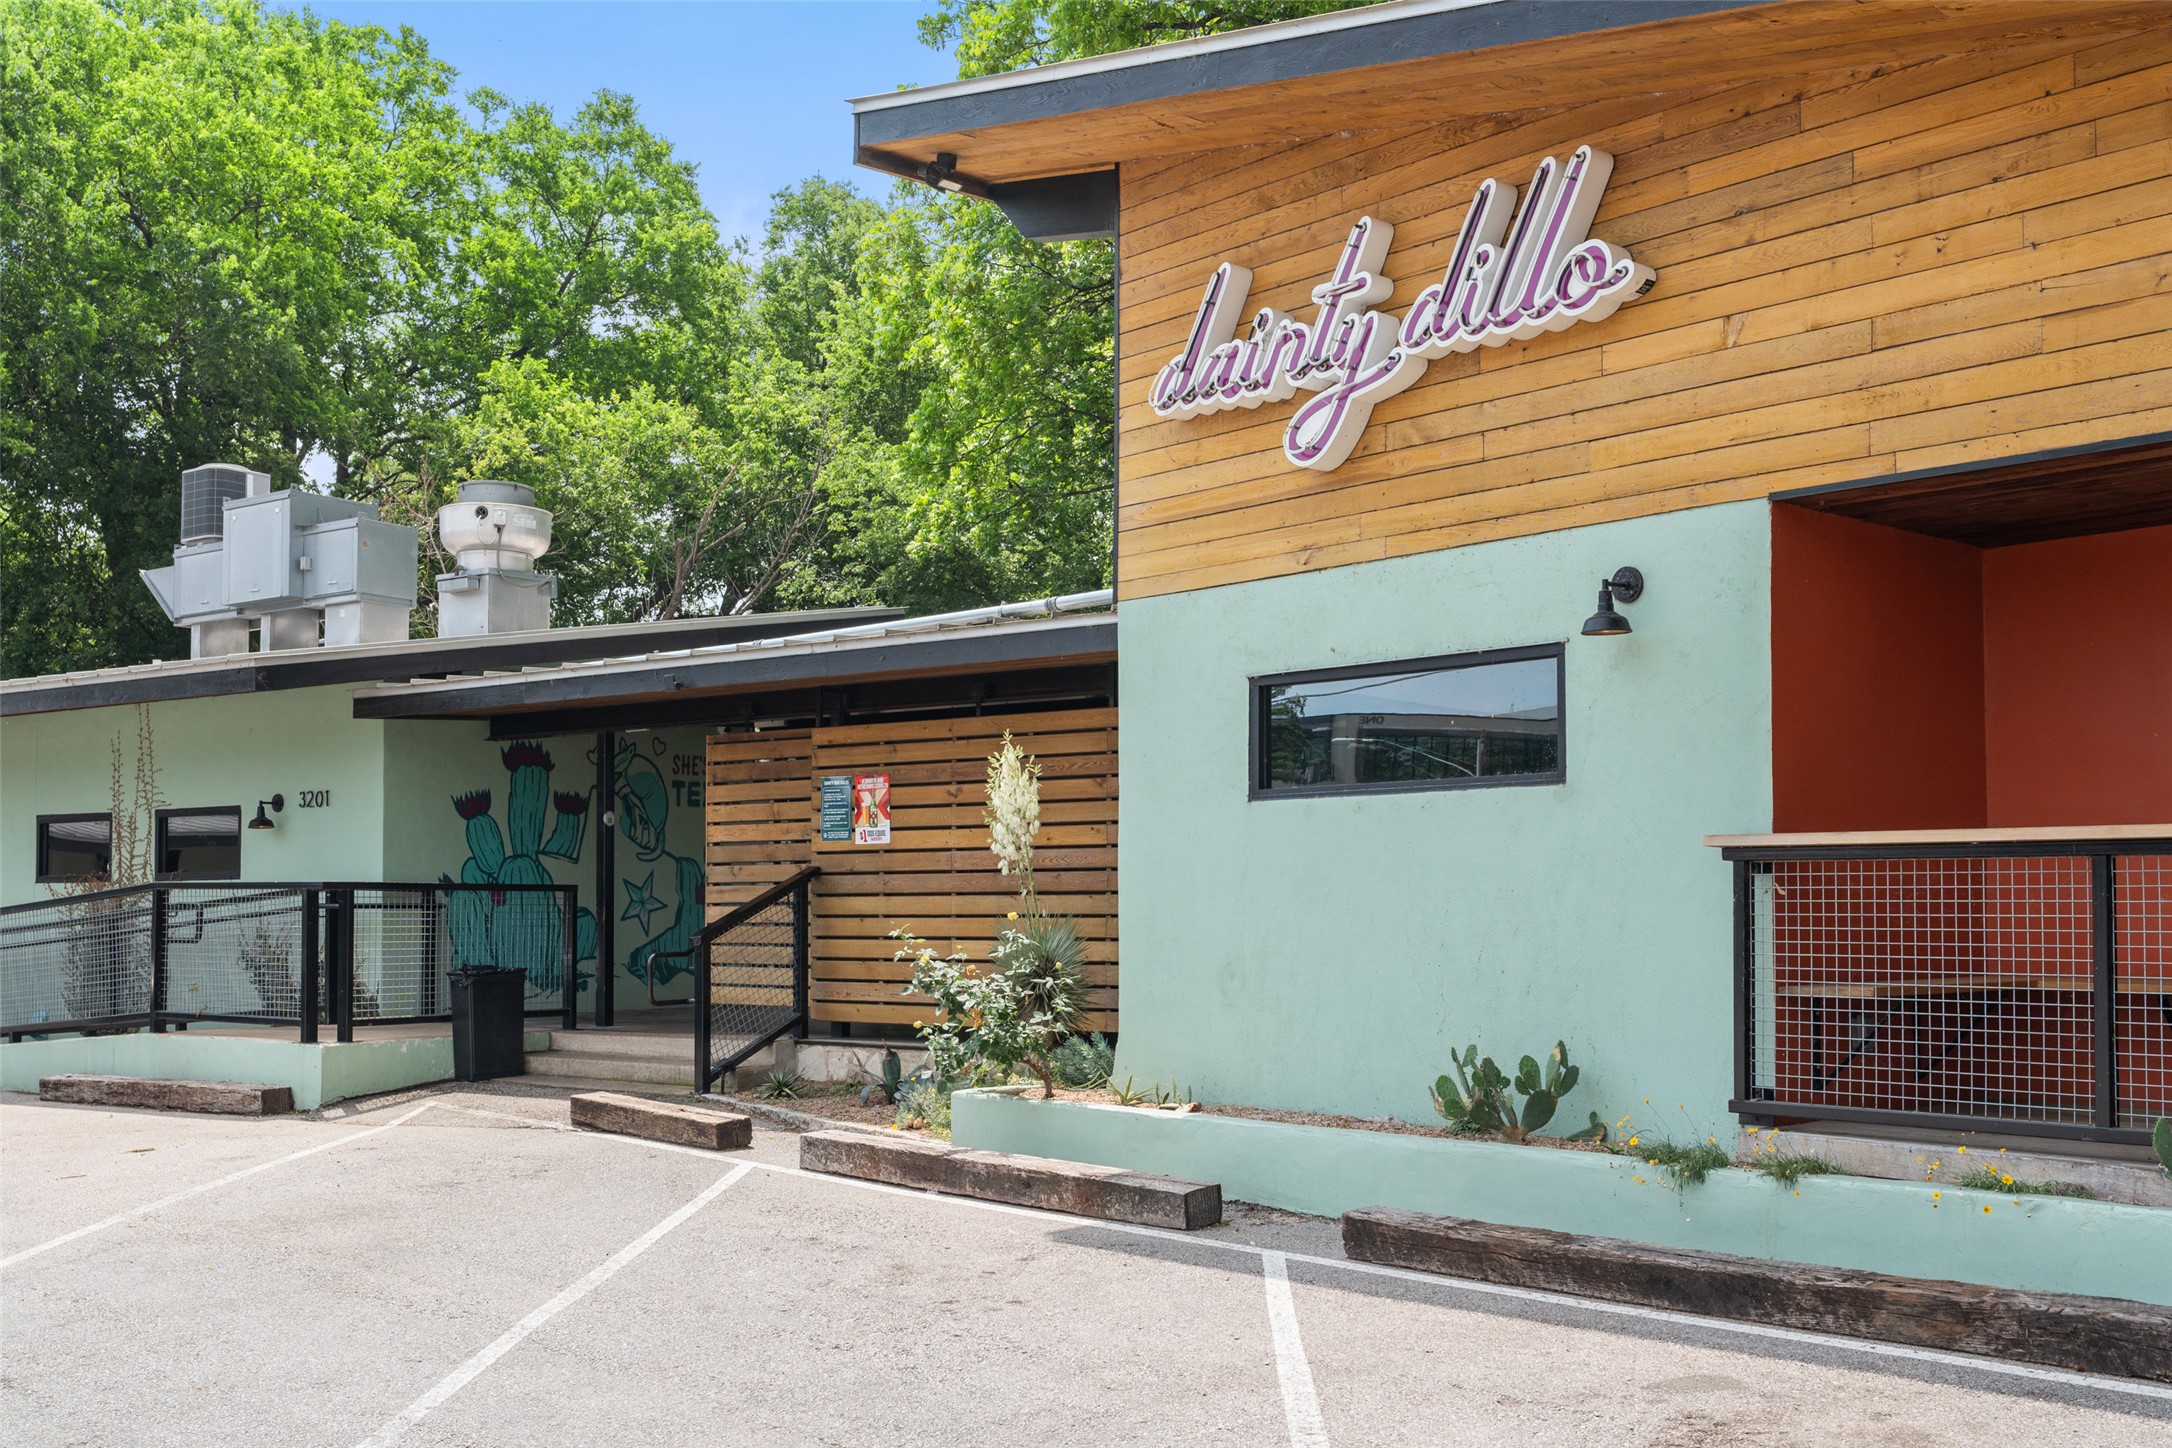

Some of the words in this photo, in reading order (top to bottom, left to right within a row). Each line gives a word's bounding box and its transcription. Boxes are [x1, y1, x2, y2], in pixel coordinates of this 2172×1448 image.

[1149, 215, 1415, 470] dainty
[1399, 144, 1645, 356] dillo
[672, 754, 707, 776] SHE'
[298, 790, 330, 808] 3201
[672, 780, 707, 807] TE
[860, 830, 867, 842] $1
